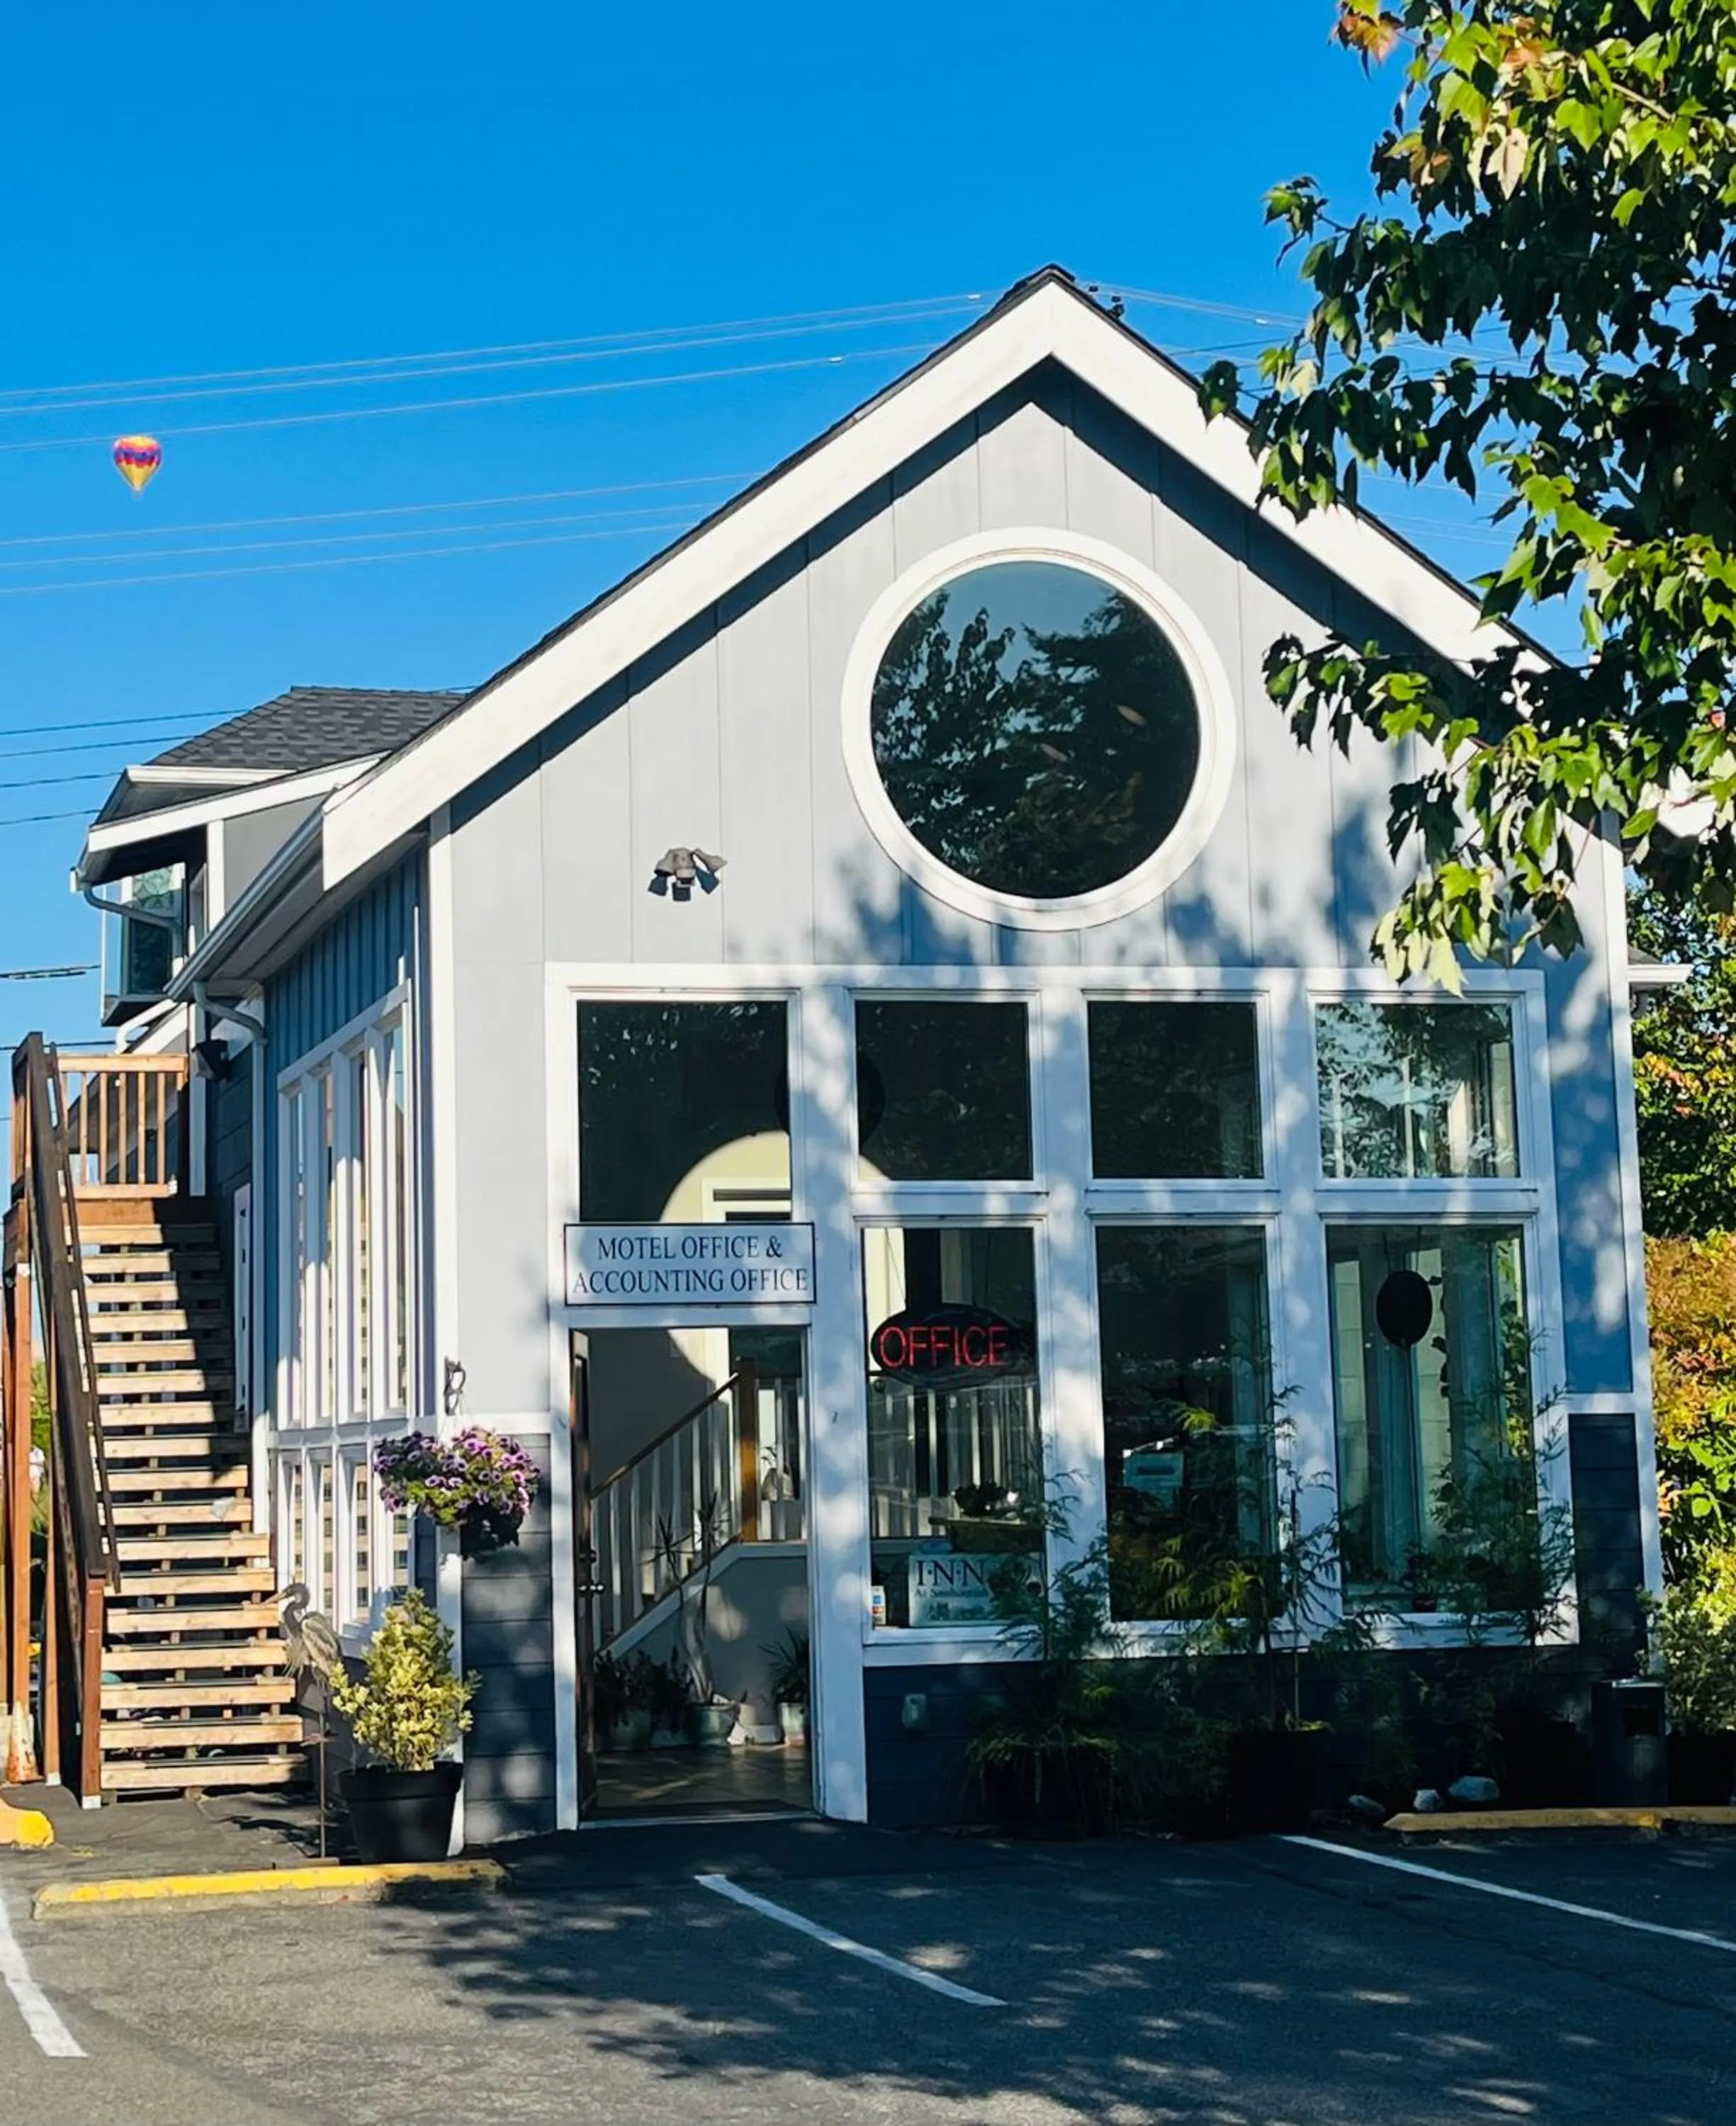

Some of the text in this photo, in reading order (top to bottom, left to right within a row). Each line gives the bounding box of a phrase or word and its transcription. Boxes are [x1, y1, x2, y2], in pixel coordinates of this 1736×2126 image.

[597, 1235, 783, 1260] MOTEL OFFICE &
[573, 1268, 808, 1294] ACCOUNTING OFFICE
[879, 1326, 1009, 1368] OFFICE
